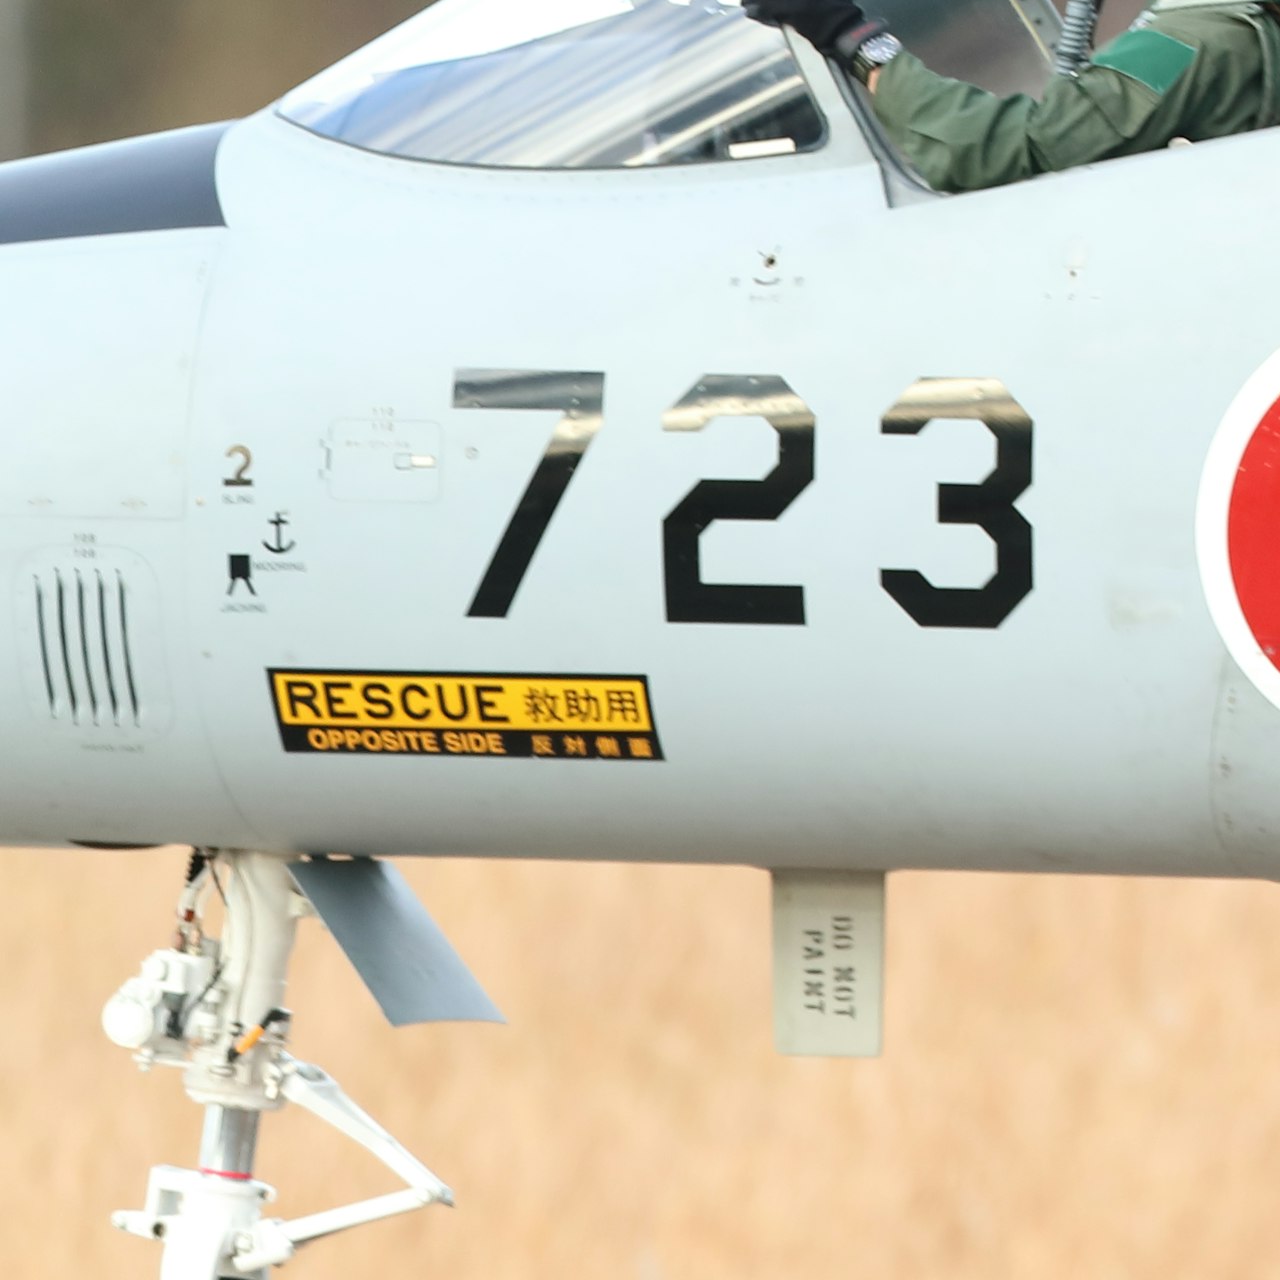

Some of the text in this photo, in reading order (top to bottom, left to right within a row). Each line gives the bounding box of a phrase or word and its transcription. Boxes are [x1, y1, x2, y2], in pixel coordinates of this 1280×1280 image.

[452, 368, 1034, 629] 723
[283, 679, 642, 724] RESCUE 救助用
[307, 727, 439, 755] OPPOSITE
[445, 731, 508, 756] SIDE
[832, 915, 857, 952] DO
[801, 929, 827, 1015] PAINT
